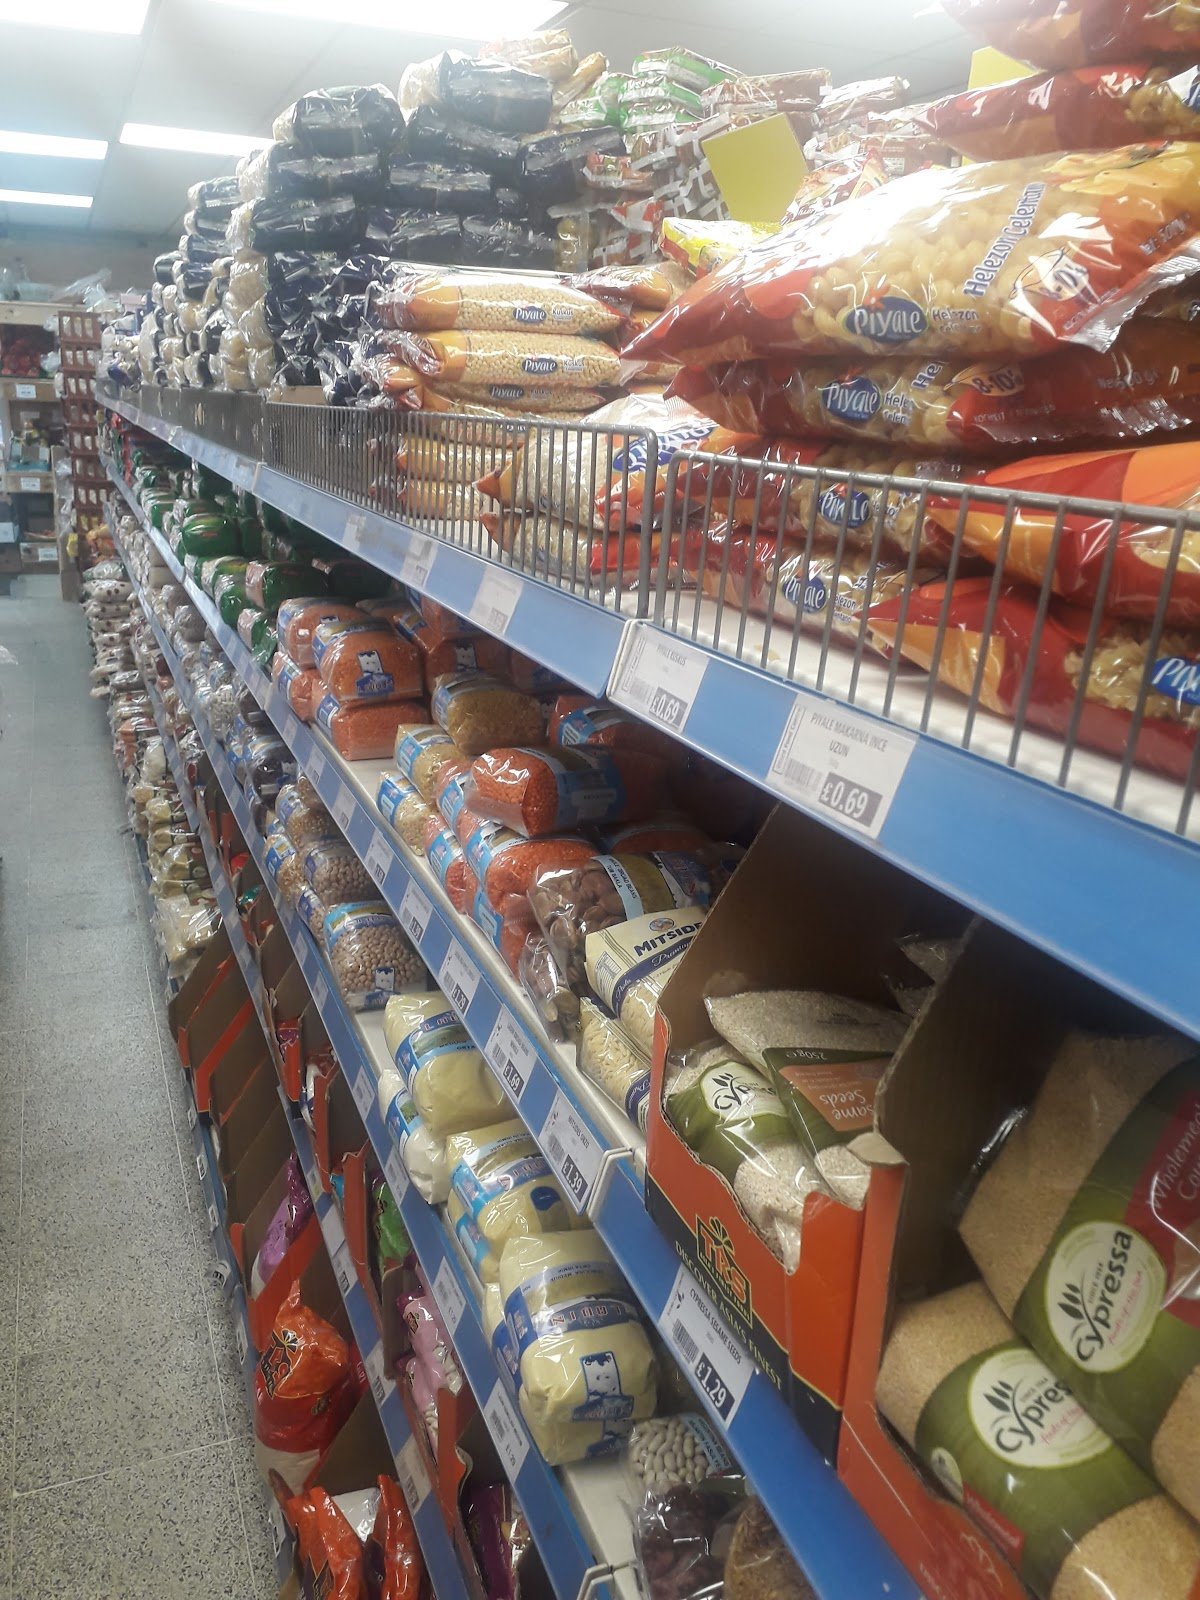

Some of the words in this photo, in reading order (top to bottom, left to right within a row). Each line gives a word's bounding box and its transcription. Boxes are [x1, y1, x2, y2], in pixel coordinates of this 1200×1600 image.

[963, 237, 1018, 297] Helezon
[515, 307, 545, 320] Piyale
[854, 308, 922, 336] Piyale
[524, 360, 556, 372] Piyale
[827, 382, 878, 414] Piyale
[651, 694, 680, 724] £0.69
[821, 781, 868, 819] £0.69
[503, 1062, 521, 1092] £1.69
[819, 1089, 866, 1107] Seeds
[562, 1161, 583, 1197] £1.39
[700, 1230, 747, 1302] TRS
[1076, 1230, 1134, 1362] Cypressa
[675, 1240, 718, 1305] DISCOVER
[749, 1339, 782, 1390] FINEST
[690, 1287, 712, 1321] CYPRESSA
[710, 1316, 729, 1345] SESAME
[726, 1340, 742, 1366] SEEDS
[697, 1361, 726, 1408] £1.29
